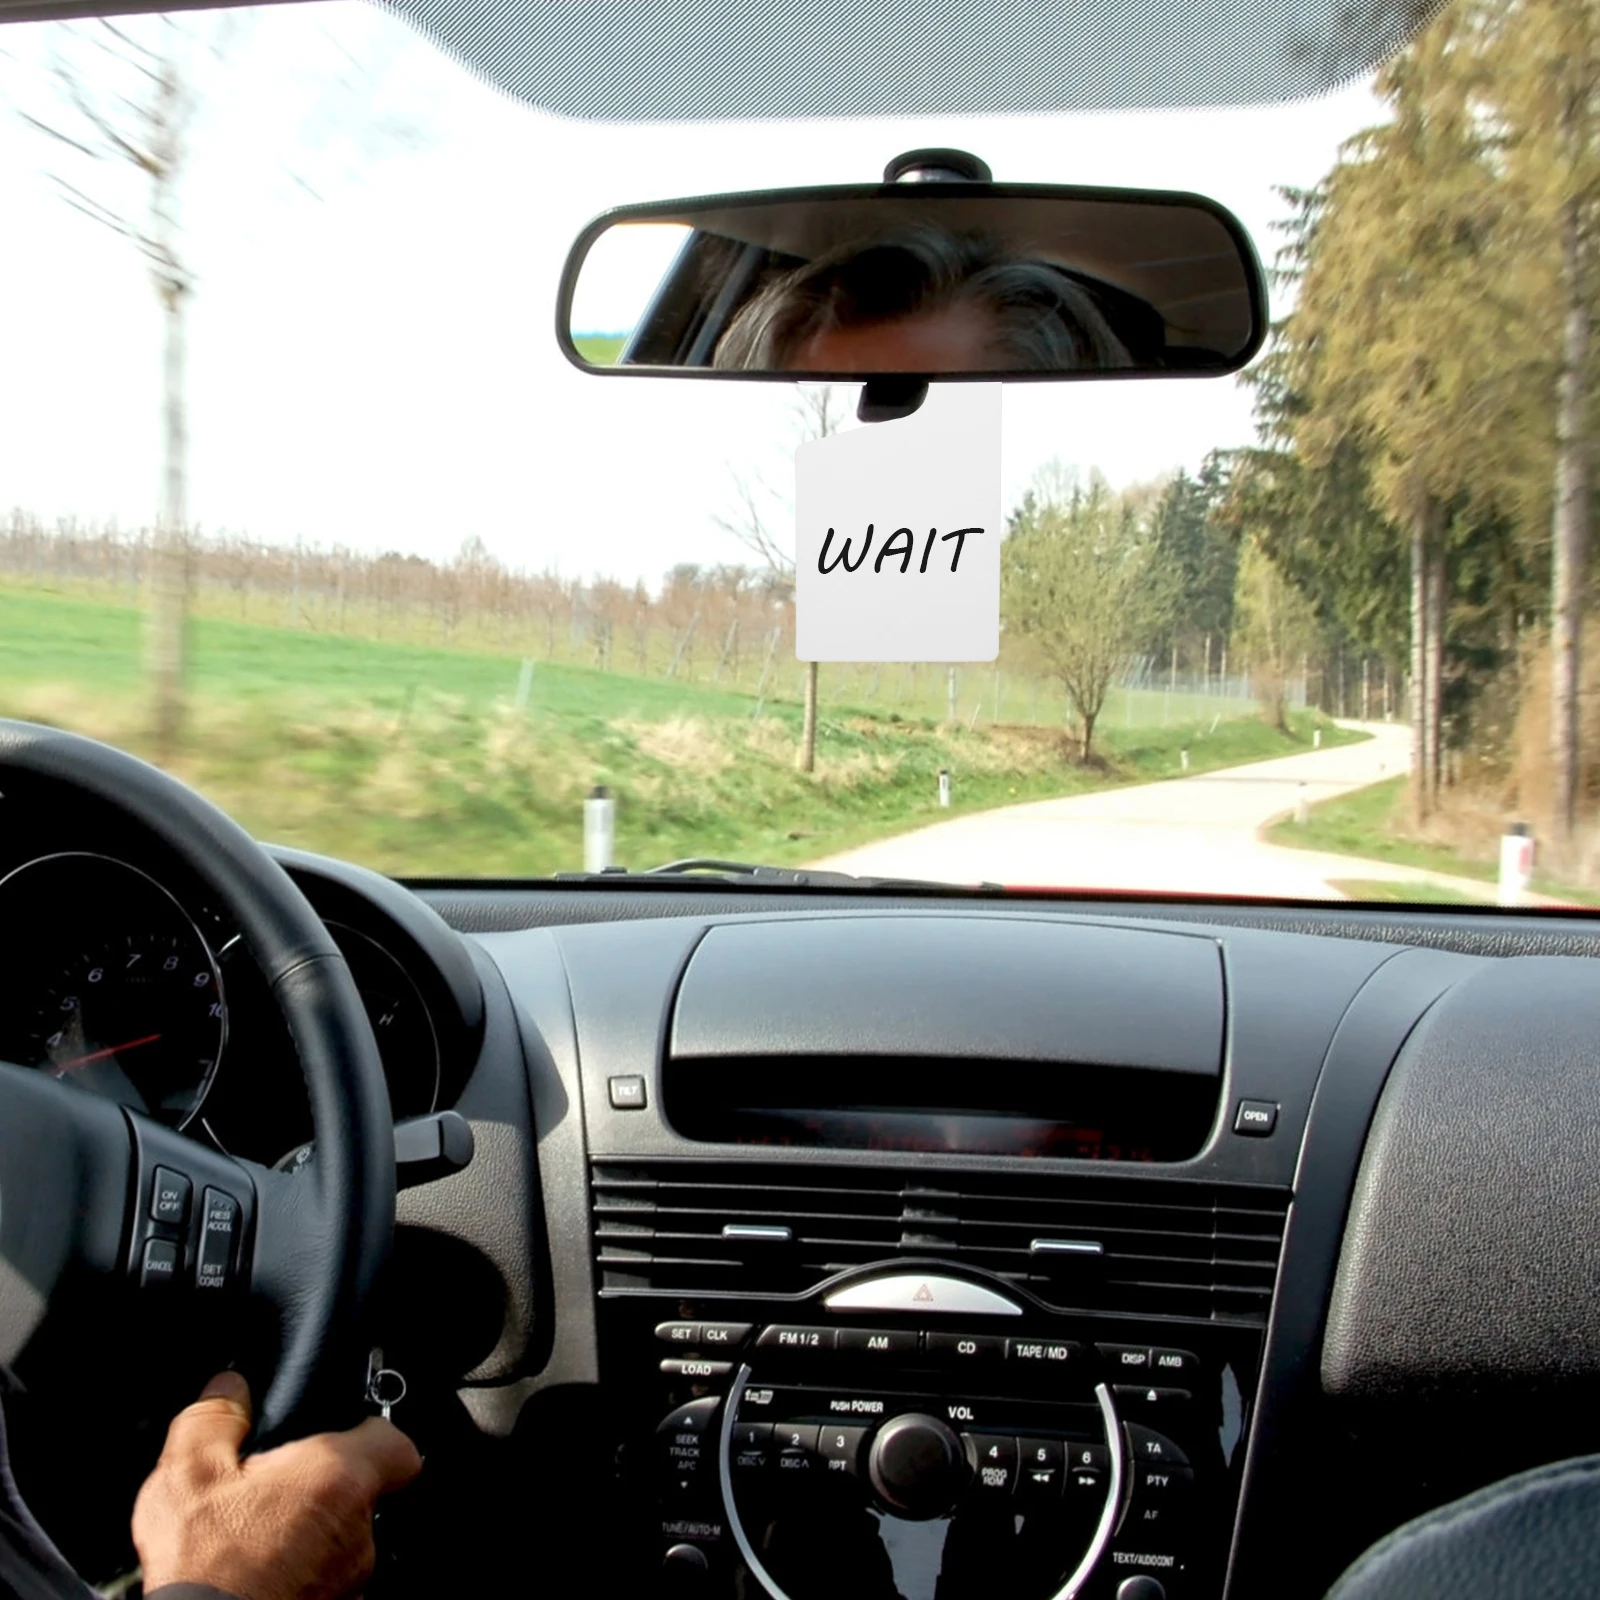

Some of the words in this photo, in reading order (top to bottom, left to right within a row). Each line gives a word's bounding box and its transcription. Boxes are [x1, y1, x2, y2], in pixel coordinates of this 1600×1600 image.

[818, 523, 985, 575] WAIT
[126, 954, 141, 968] 7
[163, 956, 178, 971] 8
[87, 967, 104, 983] 6
[193, 972, 210, 987] 9
[60, 996, 77, 1011] 5
[379, 1013, 394, 1026] H
[47, 1031, 63, 1047] 4
[1243, 1109, 1268, 1122] OPEN
[161, 1190, 178, 1200] ON
[159, 1202, 179, 1211] OFF
[207, 1221, 232, 1232] ACCEL
[146, 1261, 173, 1272] CANCEL
[203, 1264, 222, 1275] SET
[199, 1276, 224, 1288] COAST
[671, 1328, 692, 1340] SET
[706, 1329, 728, 1341] CLK
[867, 1336, 888, 1350] AM
[957, 1341, 976, 1354] CD
[1016, 1344, 1067, 1360] TAPE/MD
[1121, 1353, 1146, 1365] DISP
[1158, 1355, 1182, 1368] AMB
[681, 1363, 711, 1376] LOAD
[830, 1400, 850, 1412] PUSH
[851, 1401, 884, 1413] POWER
[948, 1405, 974, 1420] VOL
[675, 1433, 699, 1445] SEEK
[749, 1431, 755, 1443] 1
[791, 1433, 800, 1446] 2
[836, 1435, 845, 1448] 3
[669, 1446, 700, 1458] TRACK
[989, 1445, 999, 1459] 4
[1037, 1448, 1046, 1461] 5
[1146, 1442, 1162, 1454] TA
[780, 1457, 800, 1468] DISC
[1082, 1451, 1092, 1464] 6
[828, 1459, 847, 1471] RPT
[1146, 1475, 1169, 1486] PTY
[1143, 1509, 1159, 1519] AF
